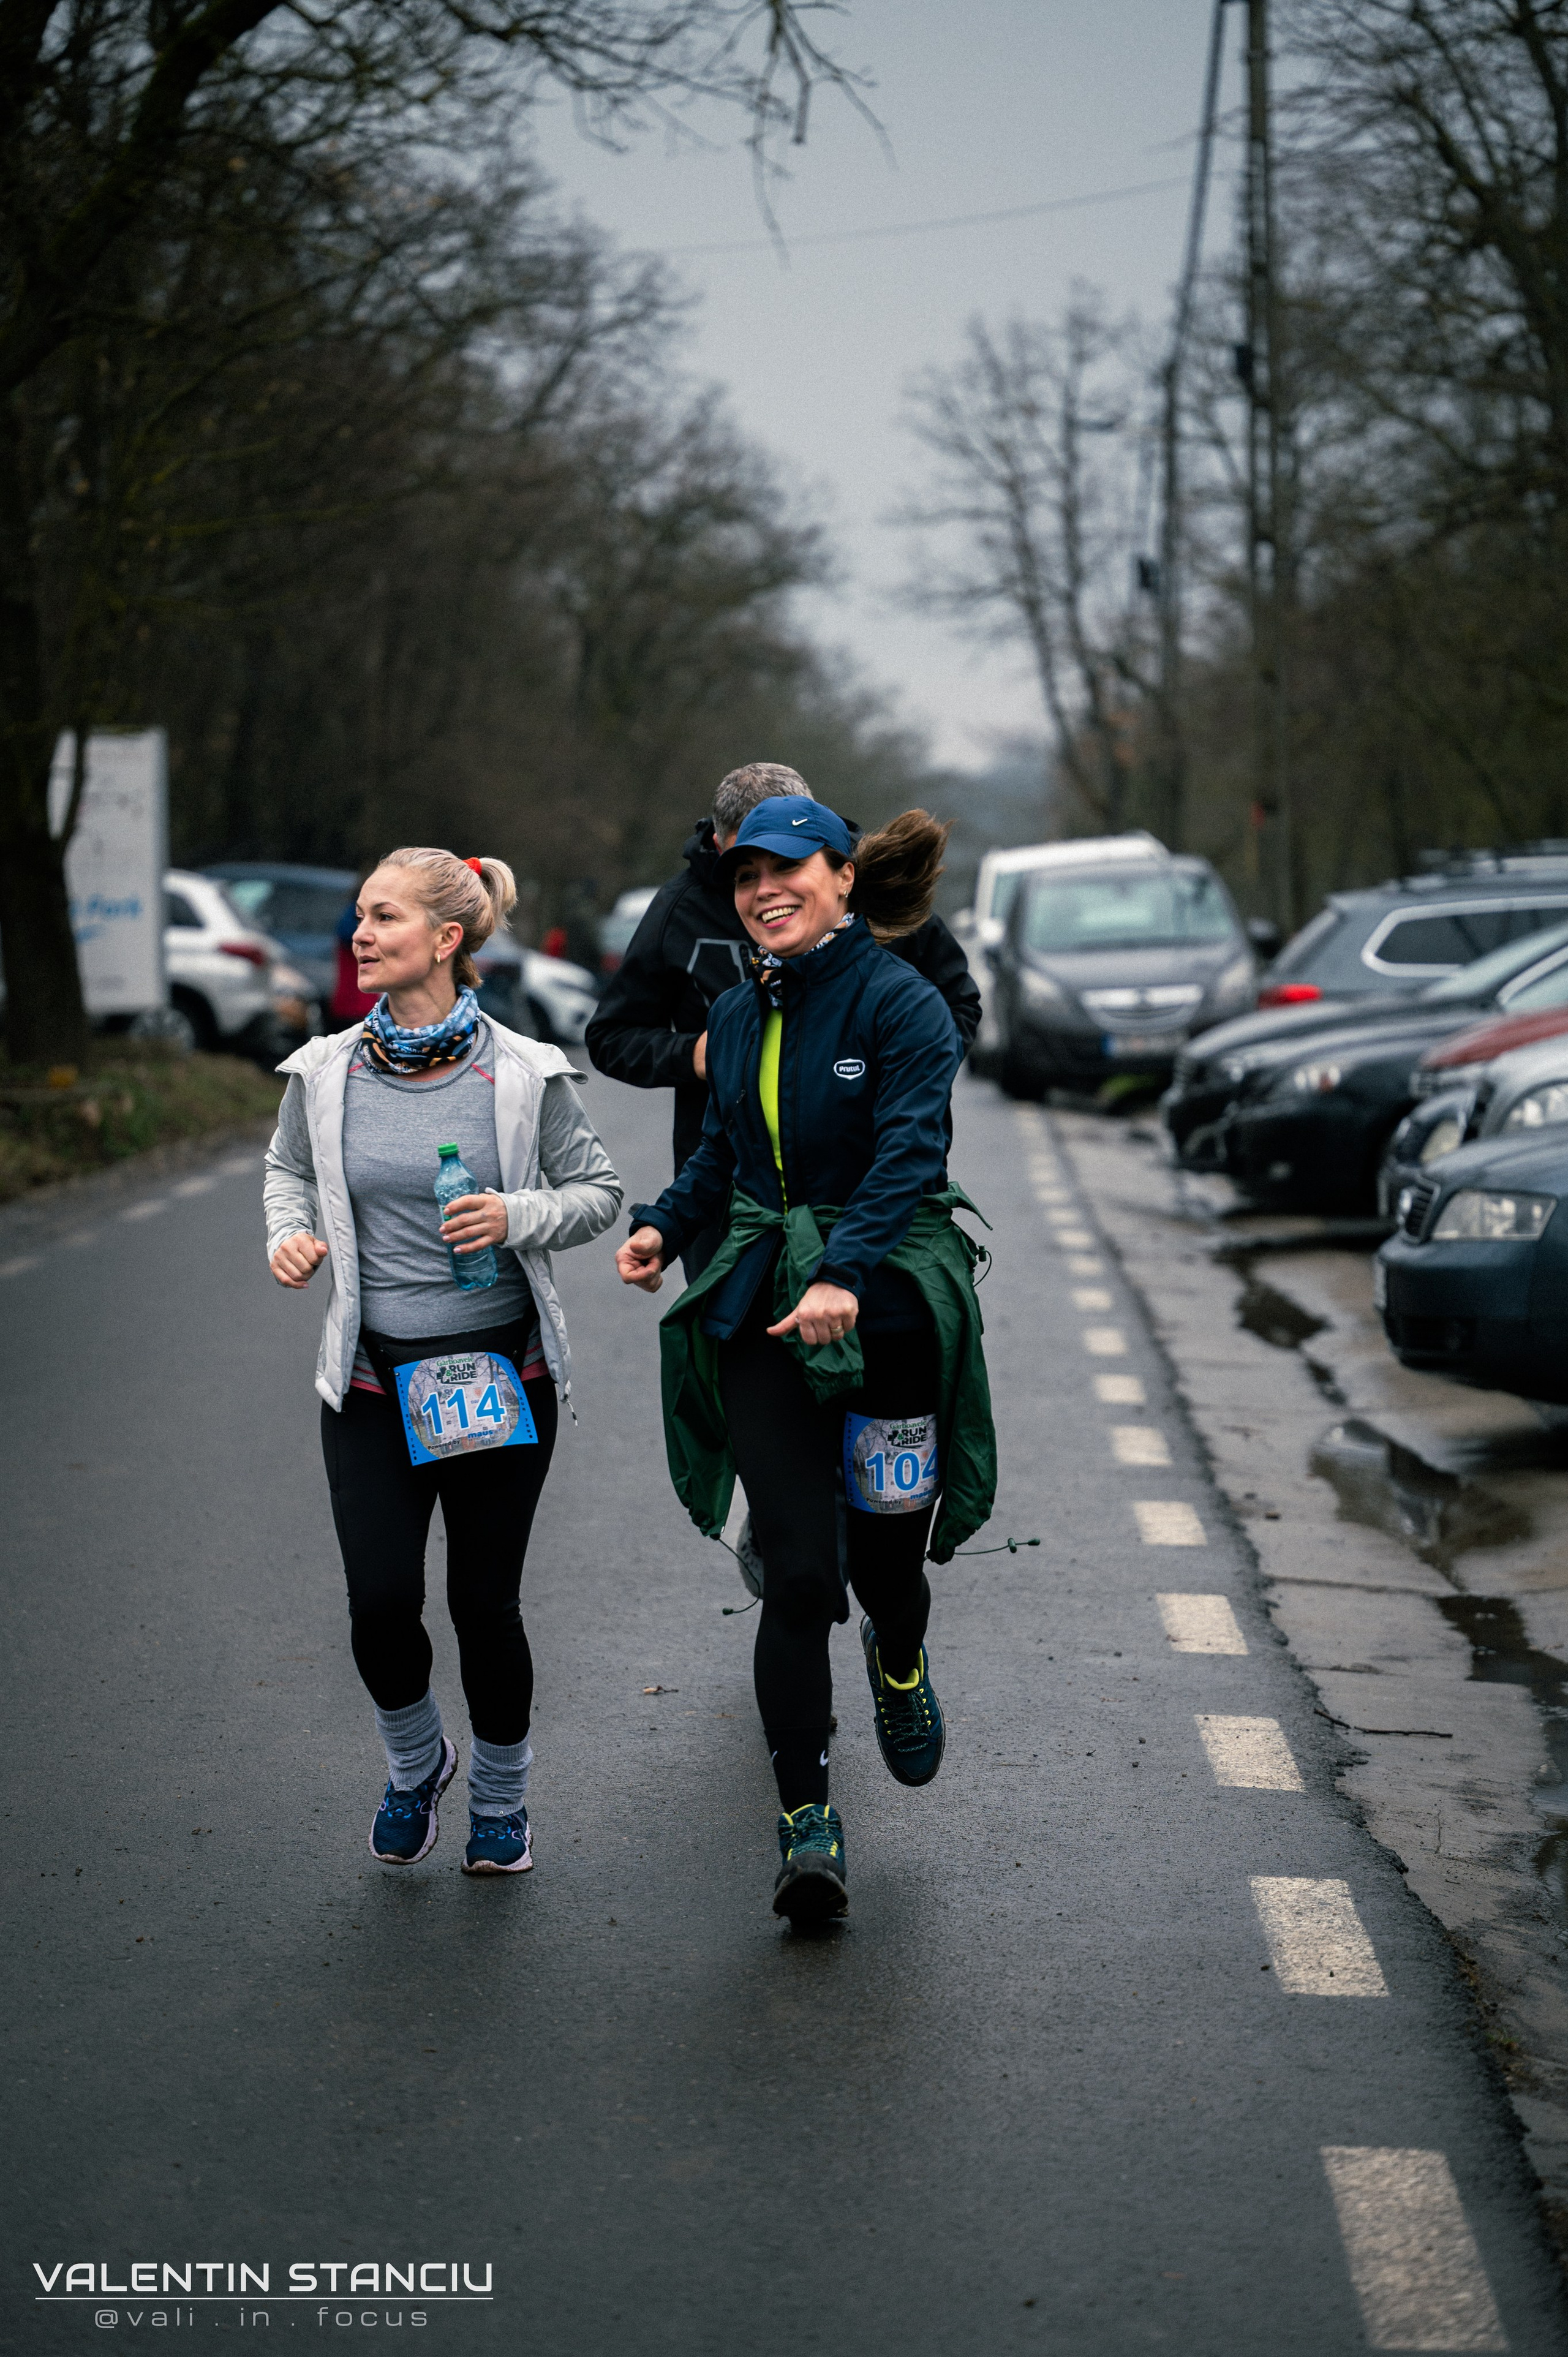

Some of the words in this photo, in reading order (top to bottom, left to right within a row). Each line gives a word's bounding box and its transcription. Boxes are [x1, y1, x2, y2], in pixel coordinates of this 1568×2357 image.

[449, 1363, 476, 1373] RUN
[451, 1371, 477, 1381] RIDE
[421, 1384, 506, 1435] 114
[468, 1430, 493, 1439] maus
[902, 1426, 927, 1436] RUN
[428, 1439, 451, 1450] Powered
[901, 1434, 927, 1445] RIDE
